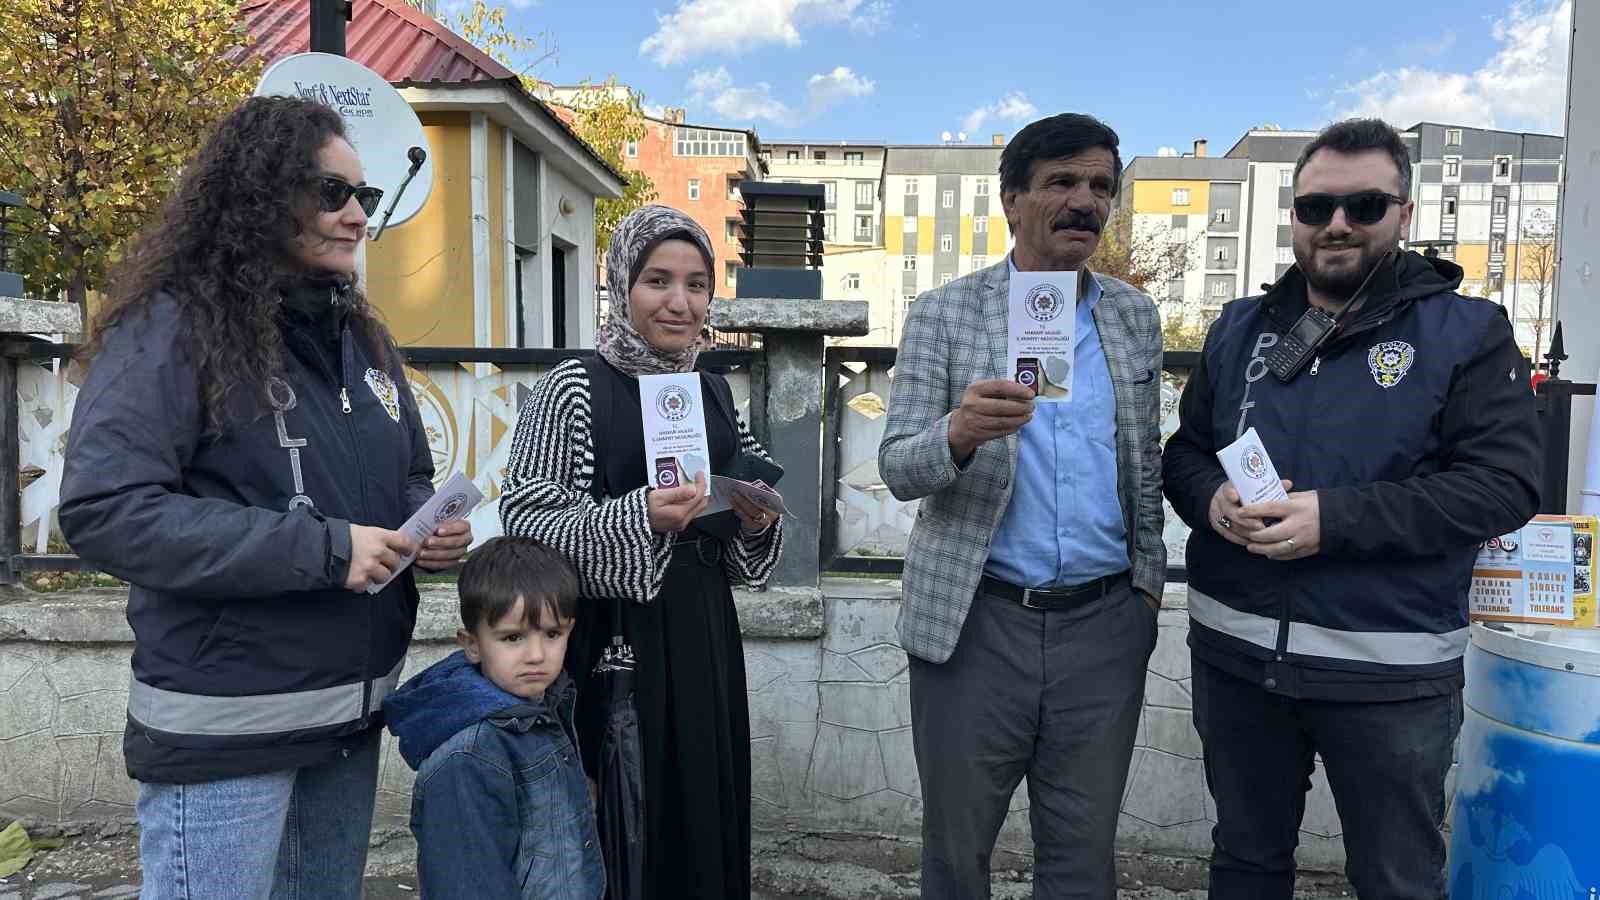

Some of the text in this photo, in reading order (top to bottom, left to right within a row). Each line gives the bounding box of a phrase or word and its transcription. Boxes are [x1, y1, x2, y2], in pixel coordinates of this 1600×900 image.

[320, 83, 329, 105] &
[329, 86, 370, 106] NextStar
[1477, 604, 1511, 613] TOLERANS
[1529, 604, 1565, 614] TOLERANS
